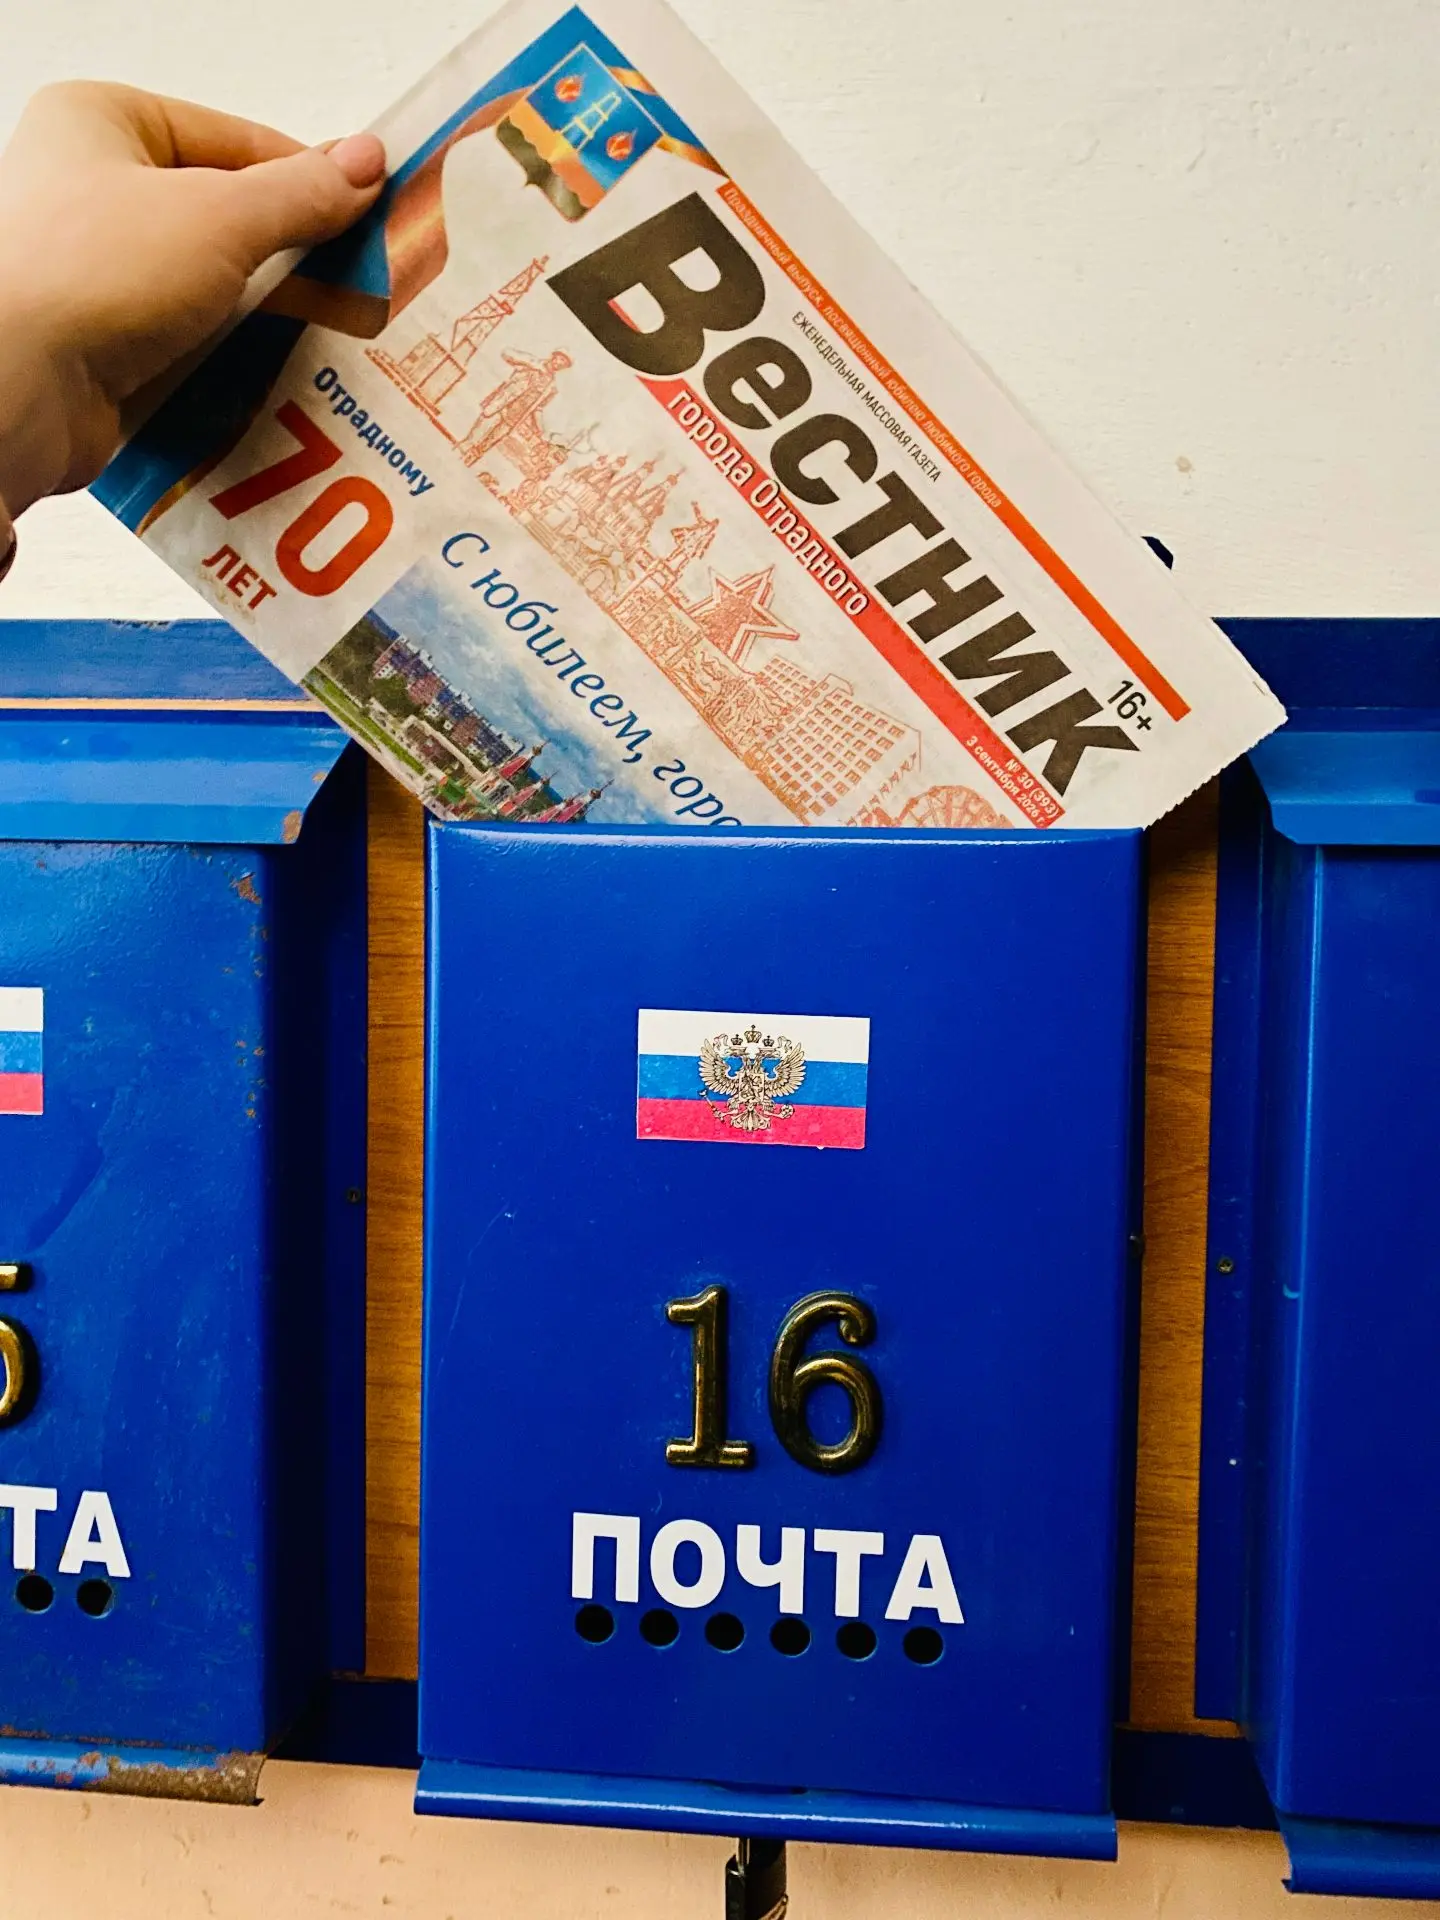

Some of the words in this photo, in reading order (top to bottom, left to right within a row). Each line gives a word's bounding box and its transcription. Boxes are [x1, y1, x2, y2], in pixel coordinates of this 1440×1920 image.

[313, 366, 435, 497] Отрадному
[792, 311, 866, 395] ЕЖЕНЕДЕЛЬНАЯ
[861, 391, 912, 448] МАССОВАЯ
[907, 443, 942, 483] ГАЗЕТА
[208, 399, 394, 597] 70
[545, 190, 1140, 797] Вестник
[667, 390, 754, 488] города
[750, 478, 869, 617] Отрадного
[922, 419, 970, 474] любимого
[967, 471, 1003, 509] города
[201, 543, 278, 610] ЛЕТ
[441, 532, 491, 569] С
[469, 568, 653, 764] юбилеем,
[1107, 680, 1152, 731] 16+
[966, 735, 978, 747] 3
[974, 744, 1019, 796] сентября
[1016, 770, 1034, 790] 30
[1029, 787, 1060, 818] (393)
[664, 1283, 886, 1477] 16
[571, 1511, 965, 1625] ПОЧТА
